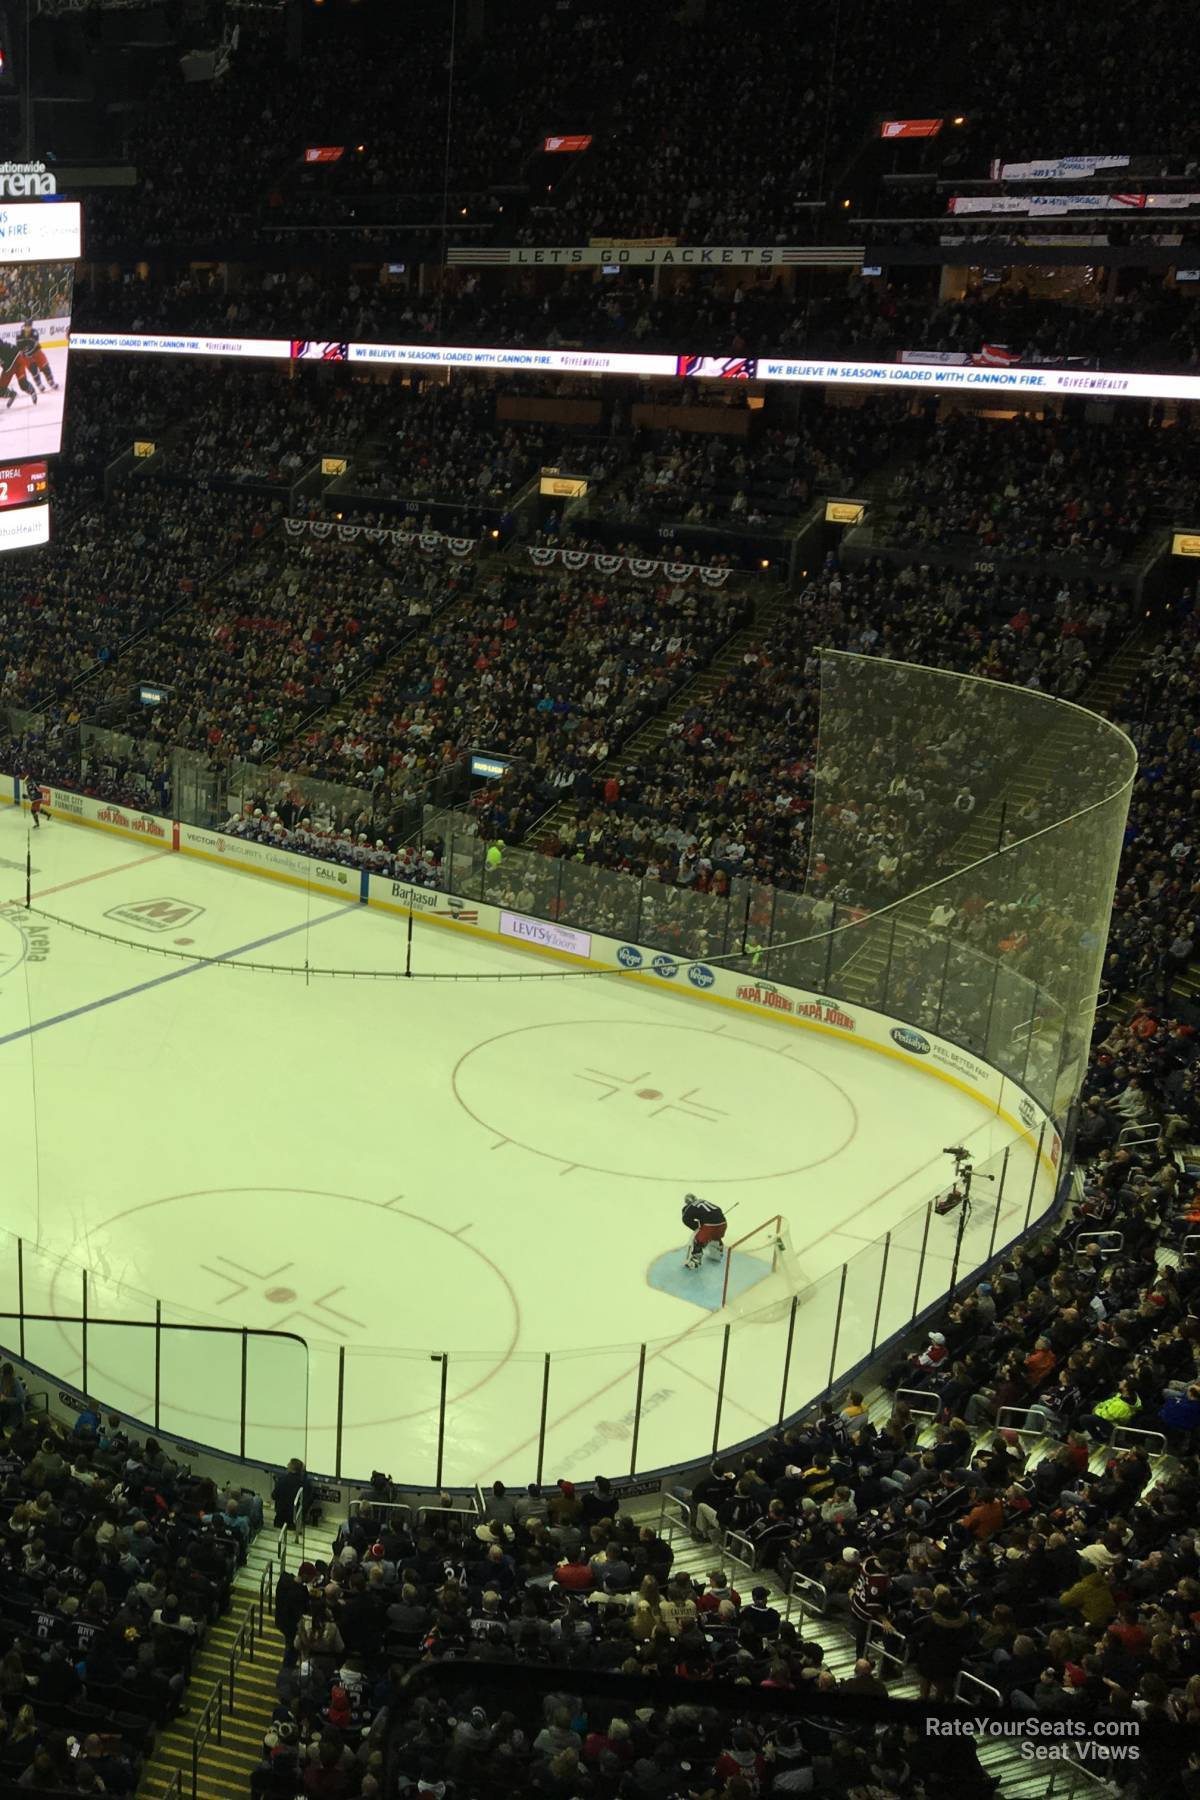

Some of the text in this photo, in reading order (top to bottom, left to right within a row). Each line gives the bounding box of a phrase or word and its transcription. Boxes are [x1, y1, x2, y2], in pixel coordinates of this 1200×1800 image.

[518, 250, 773, 262] LET'S GO JACKETS
[87, 338, 118, 346] SEASONS
[119, 339, 141, 347] LOADED
[142, 340, 158, 348] WITH
[159, 340, 185, 349] CANNON
[356, 348, 367, 357] WE
[368, 349, 397, 359] BELIEVE
[399, 350, 406, 358] IN
[408, 350, 441, 361] SEASONS
[442, 352, 473, 362] LOADED
[474, 353, 495, 363] WITH
[497, 354, 532, 364] CANNON
[767, 364, 784, 375] WE
[785, 365, 825, 377] BELIEVE
[826, 367, 839, 377] IN
[840, 367, 888, 379] SEASONS
[889, 369, 932, 381] LOADED
[935, 371, 964, 383] WITH
[966, 373, 1017, 385] CANNON
[27, 483, 35, 493] 13
[54, 791, 70, 803] VALUE
[71, 796, 83, 805] CITY
[54, 801, 83, 816] FURNITURE
[186, 833, 262, 860] VECTOR SECURITY
[316, 866, 336, 880] CALL
[392, 882, 438, 907] Barbasol
[22, 925, 50, 962] Arena
[619, 948, 641, 967] Kroger
[690, 967, 713, 986] Kroger
[736, 987, 761, 1003] PAPA
[798, 1004, 822, 1021] PAPA
[894, 1030, 930, 1052] Pedialyte
[933, 1044, 949, 1058] FEEL
[950, 1053, 975, 1070] BETTER
[975, 1067, 990, 1079] FAST
